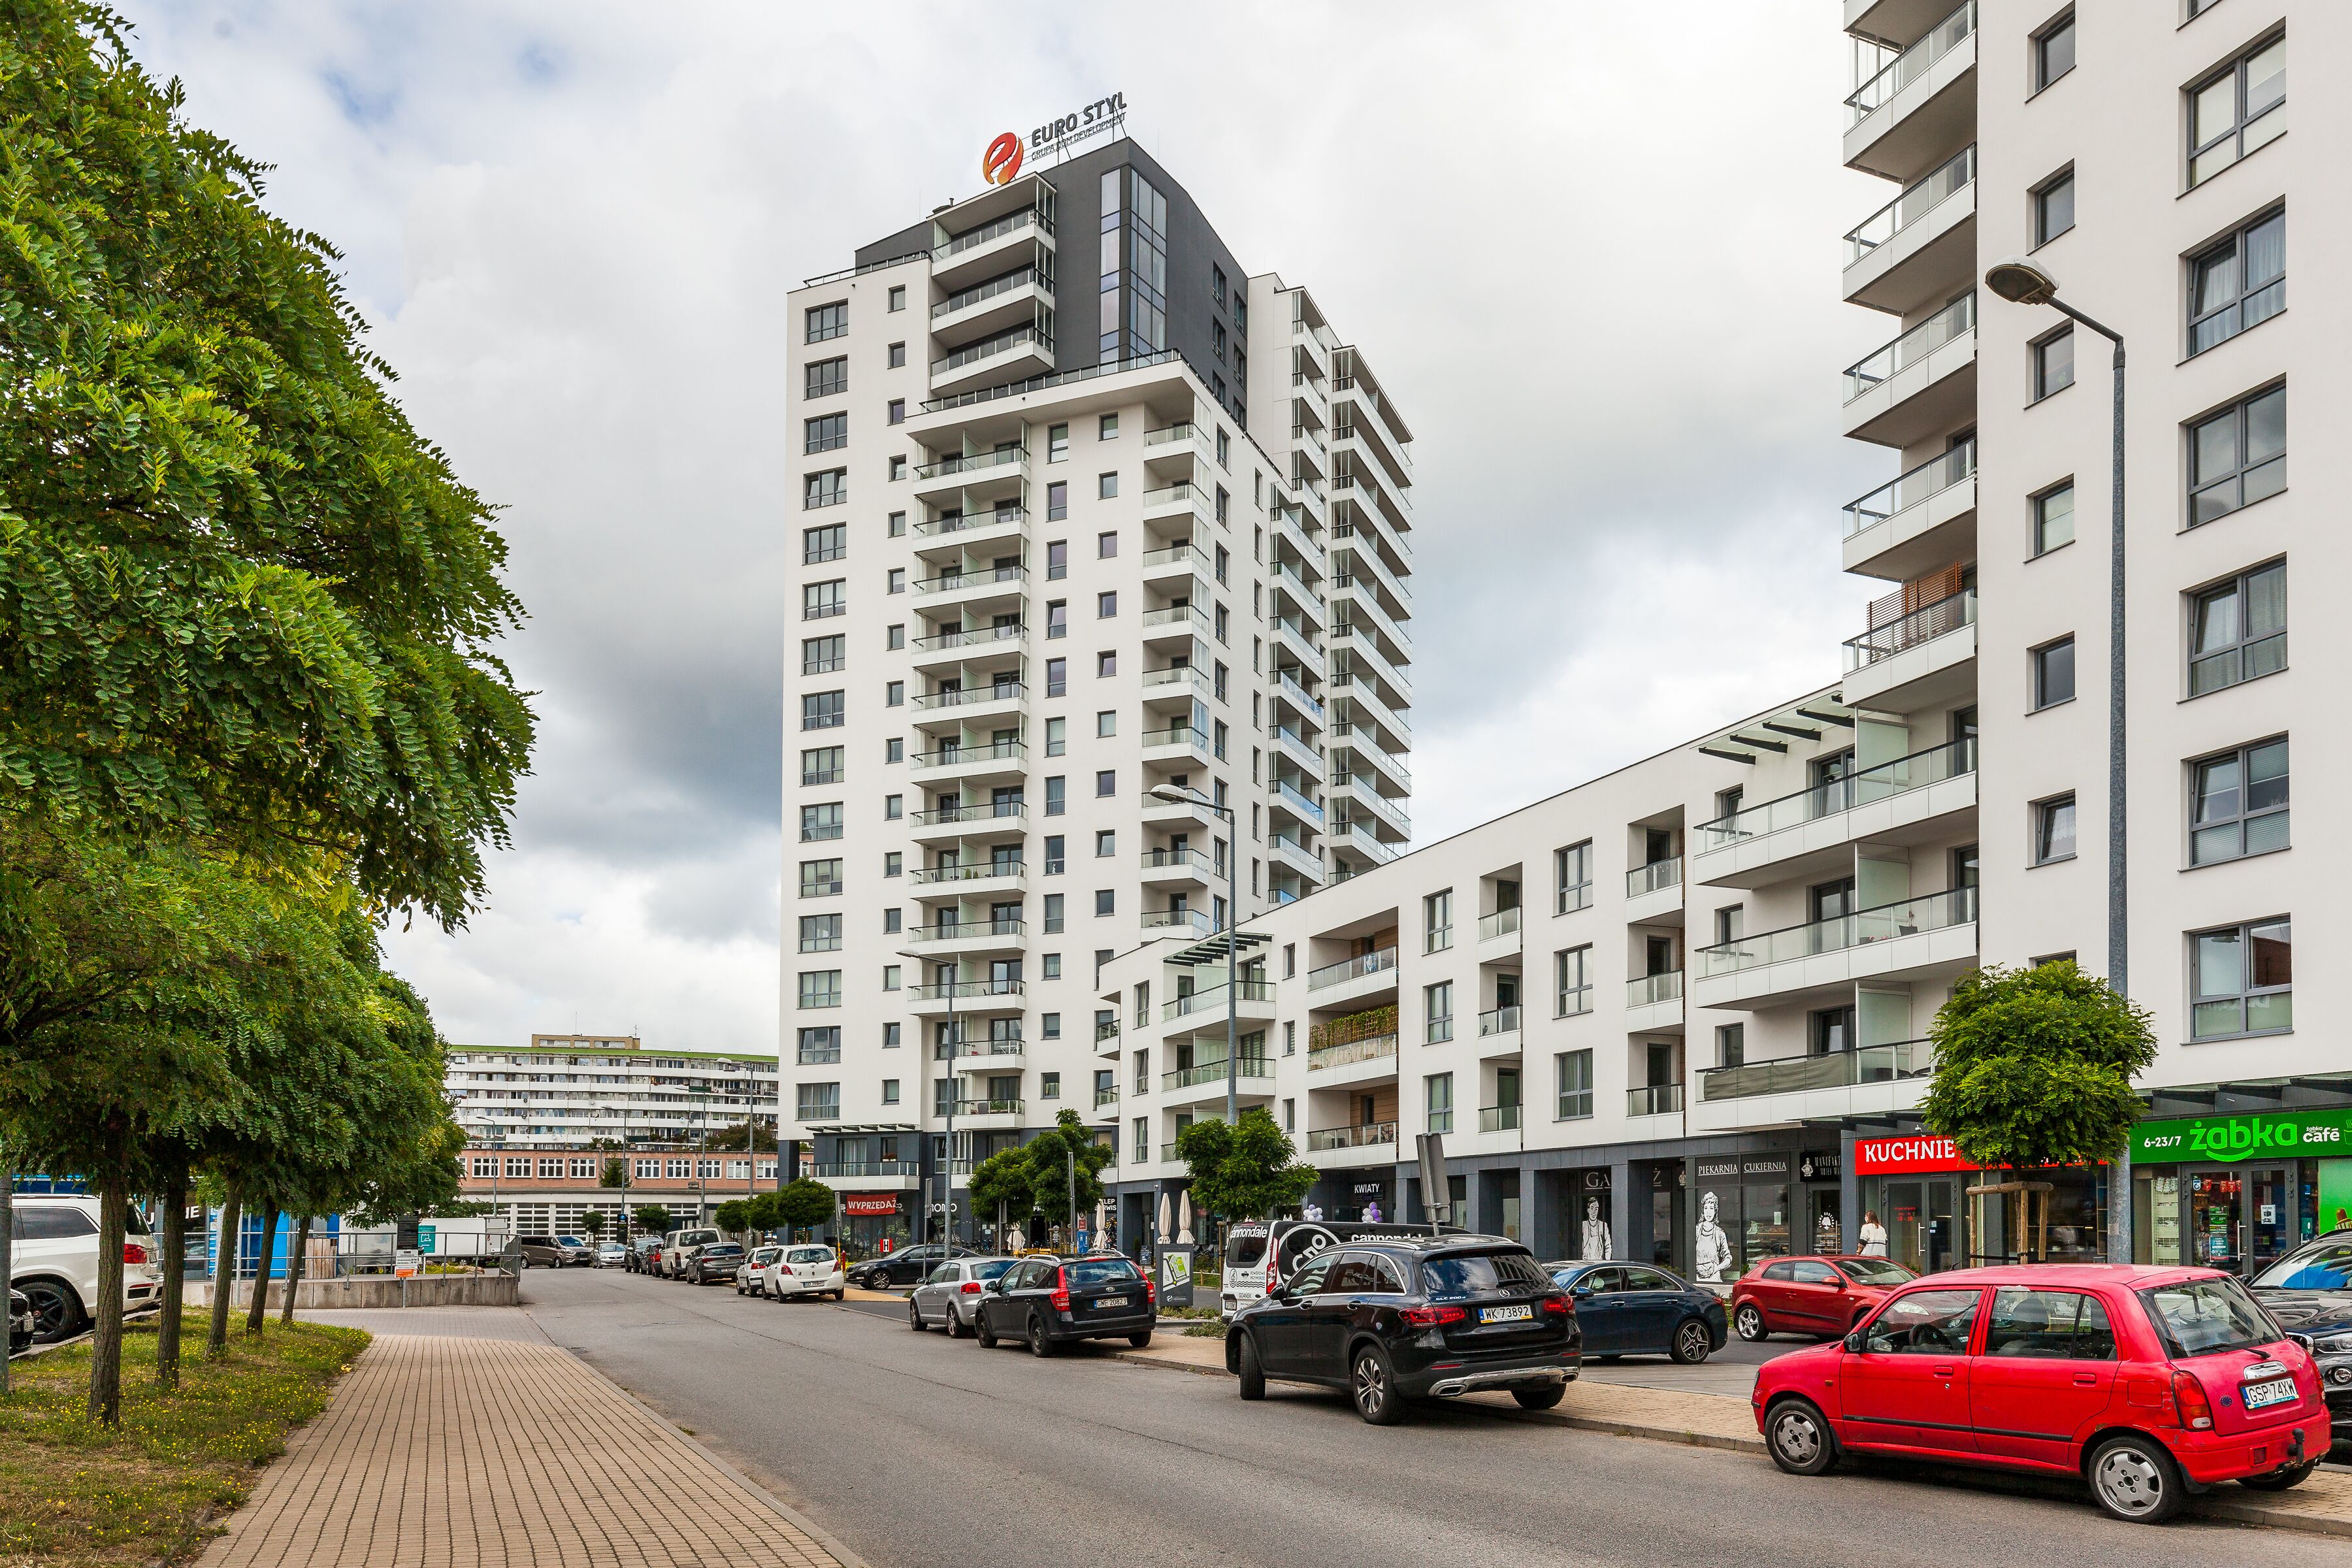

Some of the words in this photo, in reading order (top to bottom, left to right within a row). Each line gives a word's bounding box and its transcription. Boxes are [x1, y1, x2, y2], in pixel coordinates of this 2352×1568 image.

[1032, 113, 1077, 147] EURO
[1083, 91, 1127, 125] STYL
[1032, 144, 1055, 161] GRUPA
[1056, 137, 1075, 150] DOM
[1073, 112, 1126, 142] DEVELOPMENT
[2144, 1135, 2181, 1148] 6-23/7
[2189, 1118, 2298, 1151] żabka
[2302, 1127, 2340, 1143] café
[1865, 1139, 1955, 1162] KUCHNIE
[1698, 1164, 1738, 1175] PIEKARNIA
[1744, 1162, 1787, 1172] CUKIERNIA
[1354, 1183, 1380, 1194] KWIATY
[848, 1198, 896, 1210] WYPRZEDAŻ
[1230, 1226, 1267, 1239] annondale
[1485, 1308, 1498, 1320] WK
[1501, 1306, 1530, 1317] 73892
[2249, 1385, 2268, 1403] GSP
[2270, 1379, 2296, 1398] 74XW
